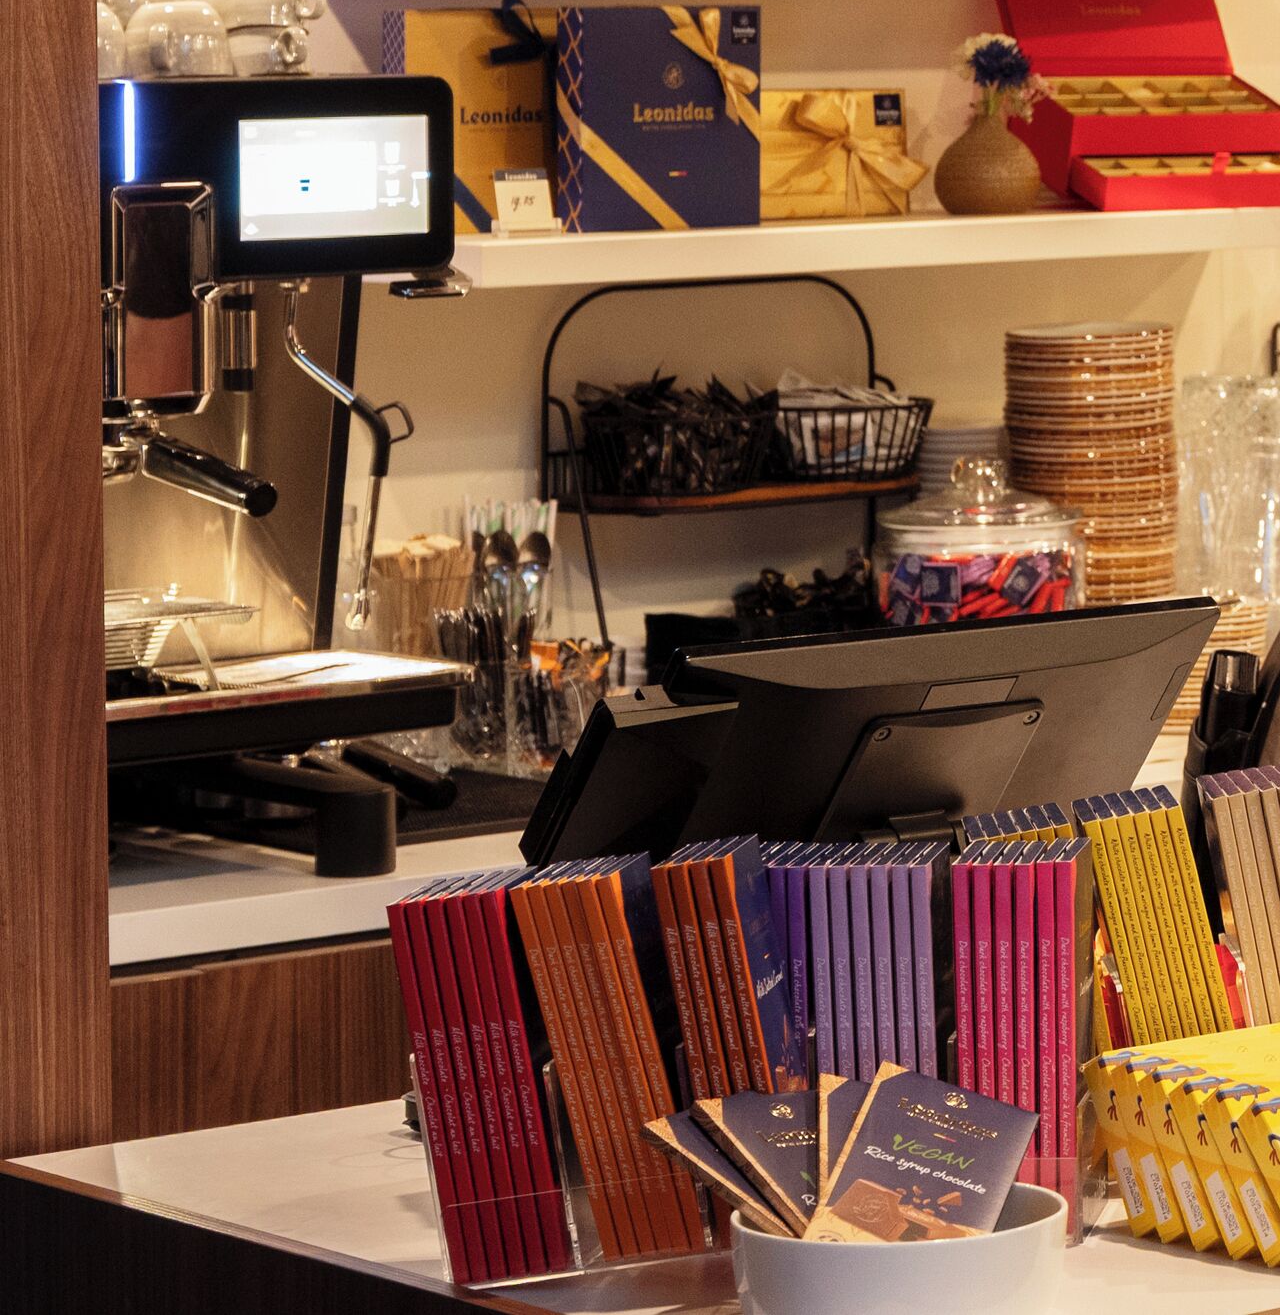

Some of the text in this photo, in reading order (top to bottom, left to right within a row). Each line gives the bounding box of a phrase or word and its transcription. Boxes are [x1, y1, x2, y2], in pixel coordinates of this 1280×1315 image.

[460, 106, 543, 126] Leonidas
[632, 101, 715, 124] Leonidas
[725, 918, 737, 937] Milk
[729, 937, 742, 973] chocolate
[1041, 939, 1051, 957] Dark
[1060, 937, 1070, 952] Dark
[735, 974, 746, 991] with
[816, 957, 826, 976] Dark
[1042, 958, 1051, 993] chocolate
[1061, 957, 1070, 992] chocolate
[706, 920, 739, 1051] Milk chocolate with salted caramel
[816, 977, 827, 1013] chocolate
[1061, 993, 1070, 1010] with
[740, 991, 752, 1017] salted
[1042, 995, 1051, 1011] with
[432, 1028, 443, 1047] Milk
[472, 1024, 483, 1042] Milk
[508, 1019, 518, 1037] Milk
[745, 1017, 759, 1049] caramel
[1040, 1012, 1051, 1048] raspberry
[1058, 1011, 1070, 1046] raspberry
[435, 1048, 448, 1083] chocolate
[475, 1043, 487, 1078] chocolate
[511, 1038, 524, 1074] chocolate
[1061, 1054, 1072, 1089] Chocolat
[1042, 1055, 1052, 1091] Chocolat
[444, 1093, 456, 1127] Chocolat
[483, 1089, 496, 1123] Chocolat
[520, 1085, 533, 1118] Chocolat
[452, 1141, 461, 1155] lait
[490, 1136, 500, 1150] lait
[528, 1131, 538, 1146] lait
[892, 1134, 975, 1171] VEGAN
[1040, 1122, 1052, 1157] framboise
[1060, 1120, 1072, 1156] framboise
[864, 1146, 987, 1195] Rice syrup chocolate
